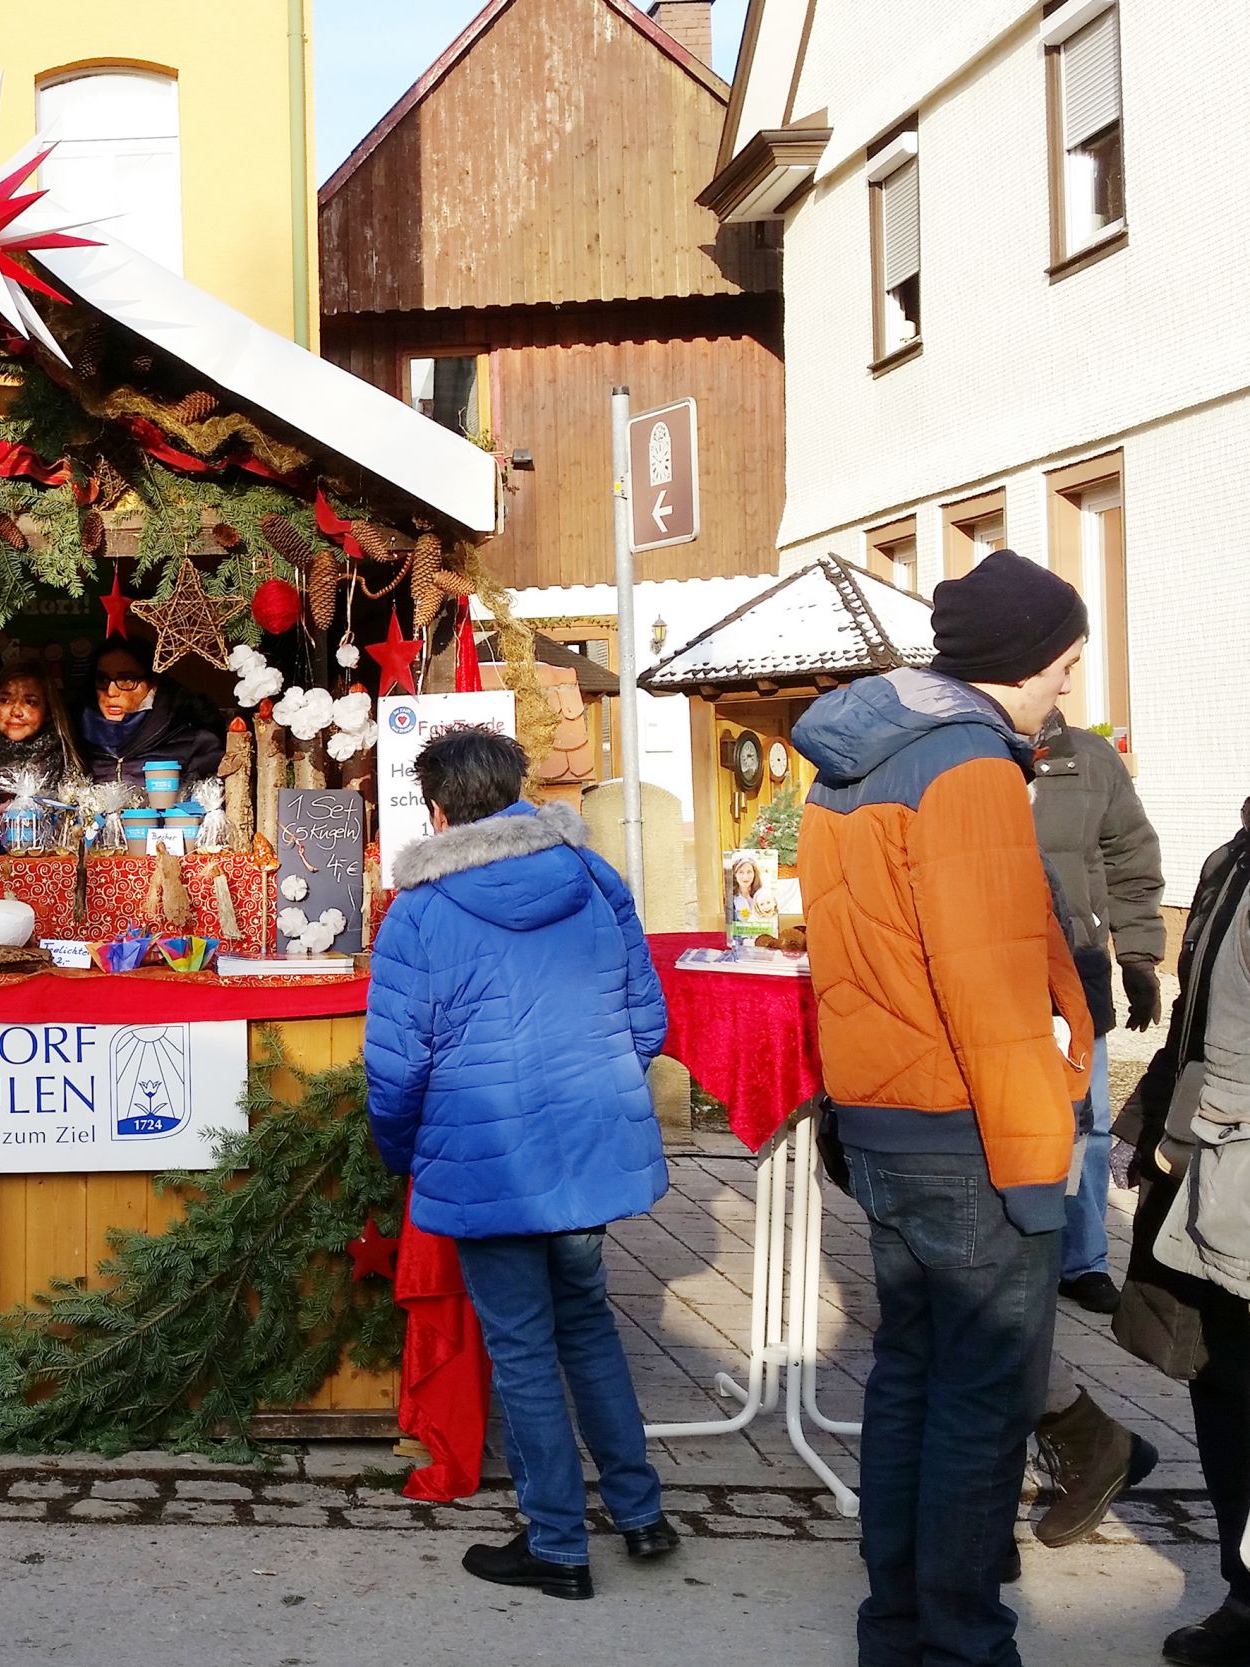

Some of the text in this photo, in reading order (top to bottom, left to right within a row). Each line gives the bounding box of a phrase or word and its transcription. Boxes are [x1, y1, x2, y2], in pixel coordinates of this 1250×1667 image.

[287, 794, 358, 820] 1 Set
[347, 861, 359, 876] €
[134, 1119, 163, 1130] 1724
[2, 1131, 46, 1145] zum
[56, 1124, 96, 1143] Ziel
